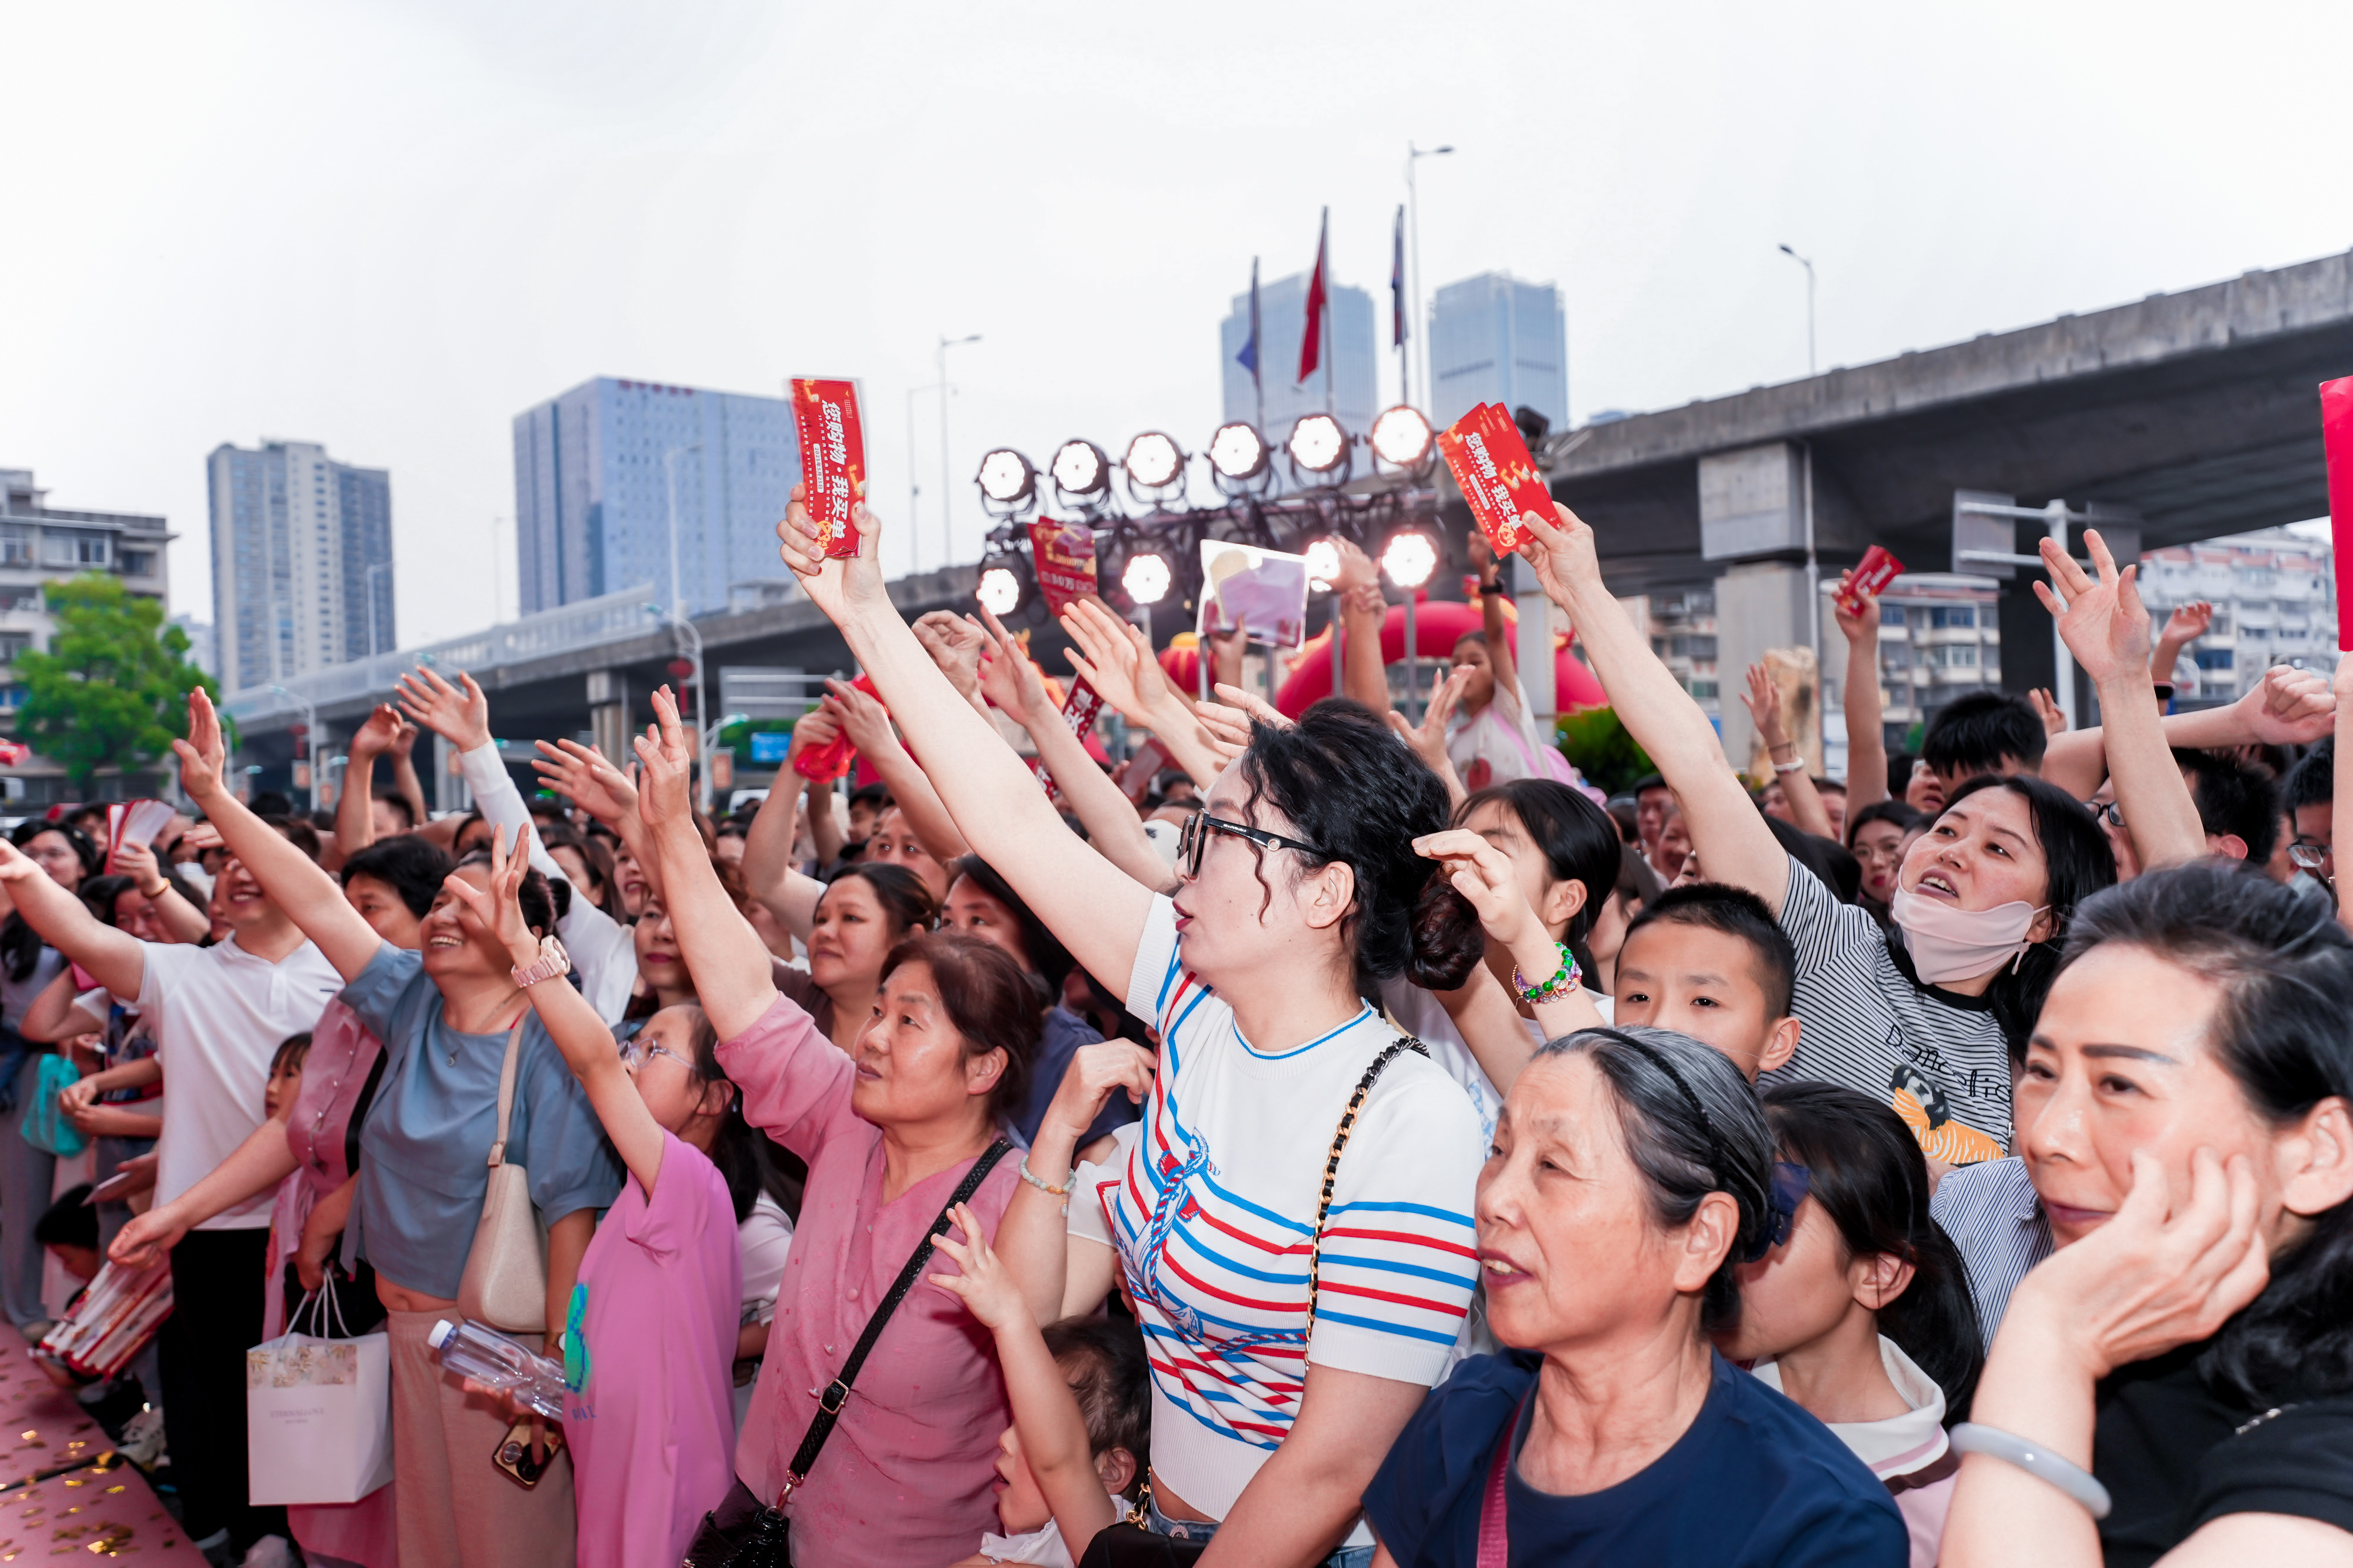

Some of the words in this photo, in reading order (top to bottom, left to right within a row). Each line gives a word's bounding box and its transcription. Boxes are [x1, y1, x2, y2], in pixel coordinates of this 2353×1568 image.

[814, 448, 823, 489] 2025年5月25日
[1465, 432, 1523, 531] 您购物·我买单
